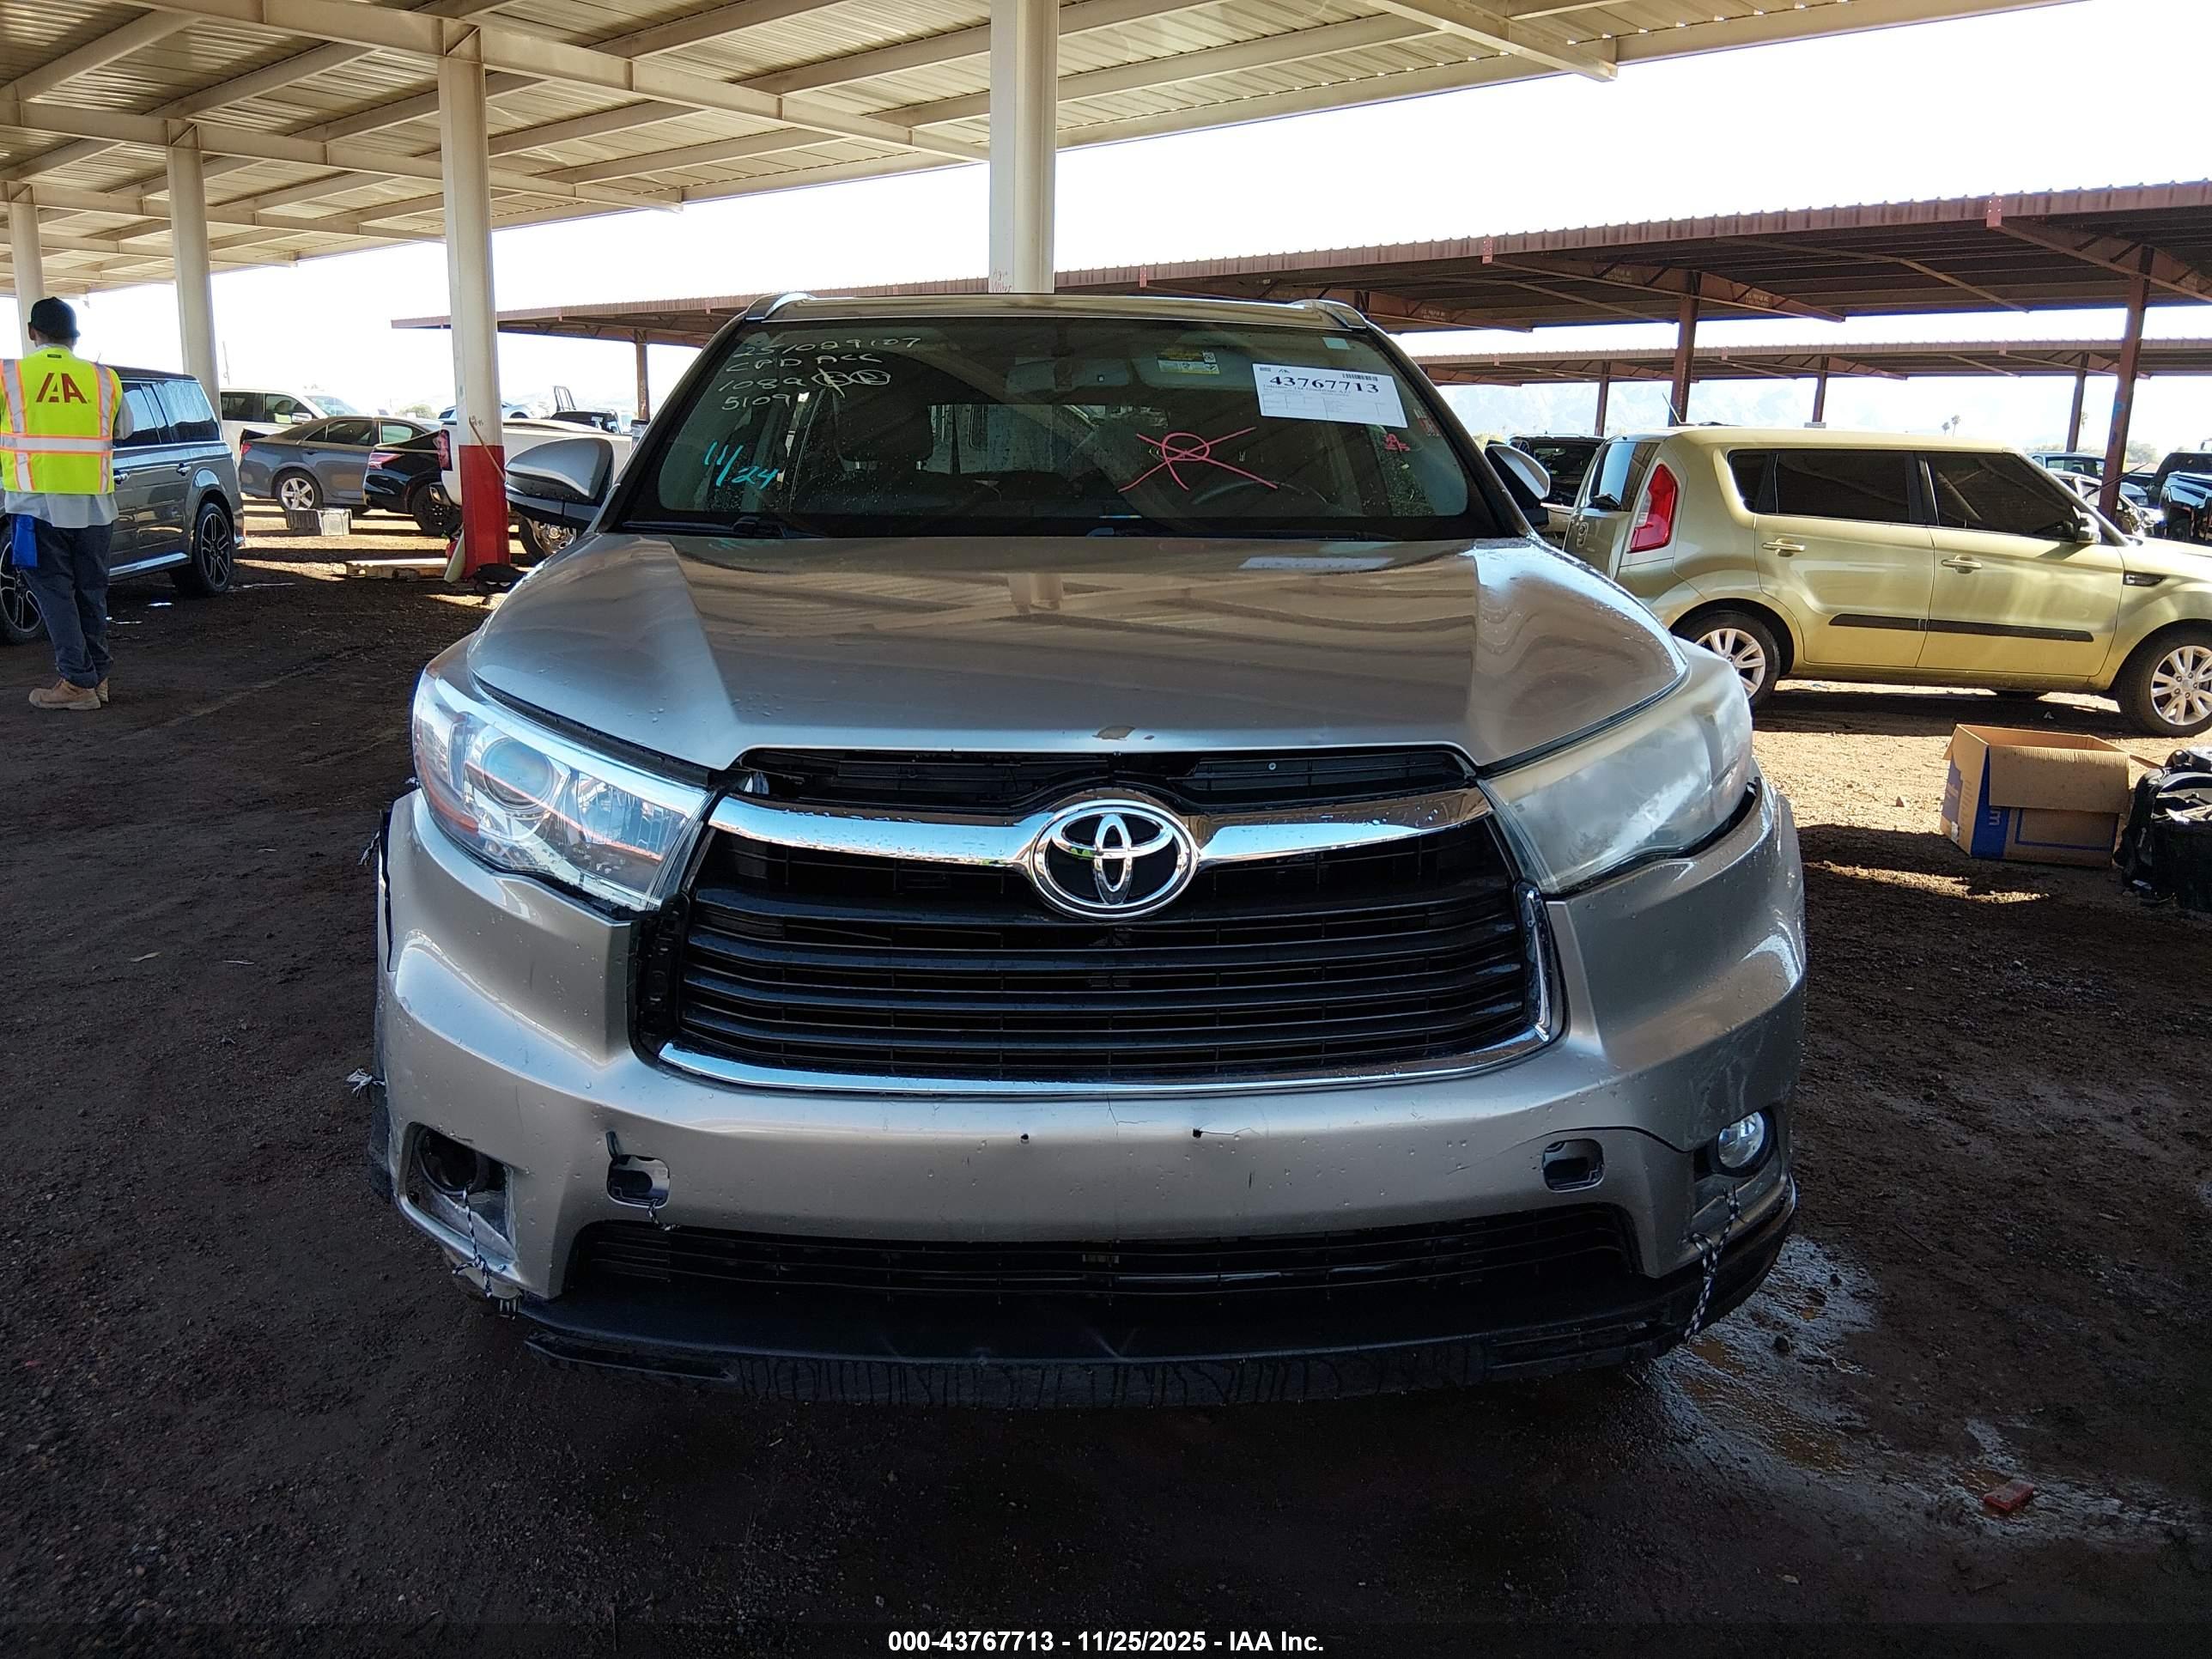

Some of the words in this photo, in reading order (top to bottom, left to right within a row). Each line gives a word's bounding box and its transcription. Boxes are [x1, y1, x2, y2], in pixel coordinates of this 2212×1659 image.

[1269, 375, 1380, 394] 43767713
[721, 393, 791, 410] 5109
[704, 441, 780, 490] 11/24
